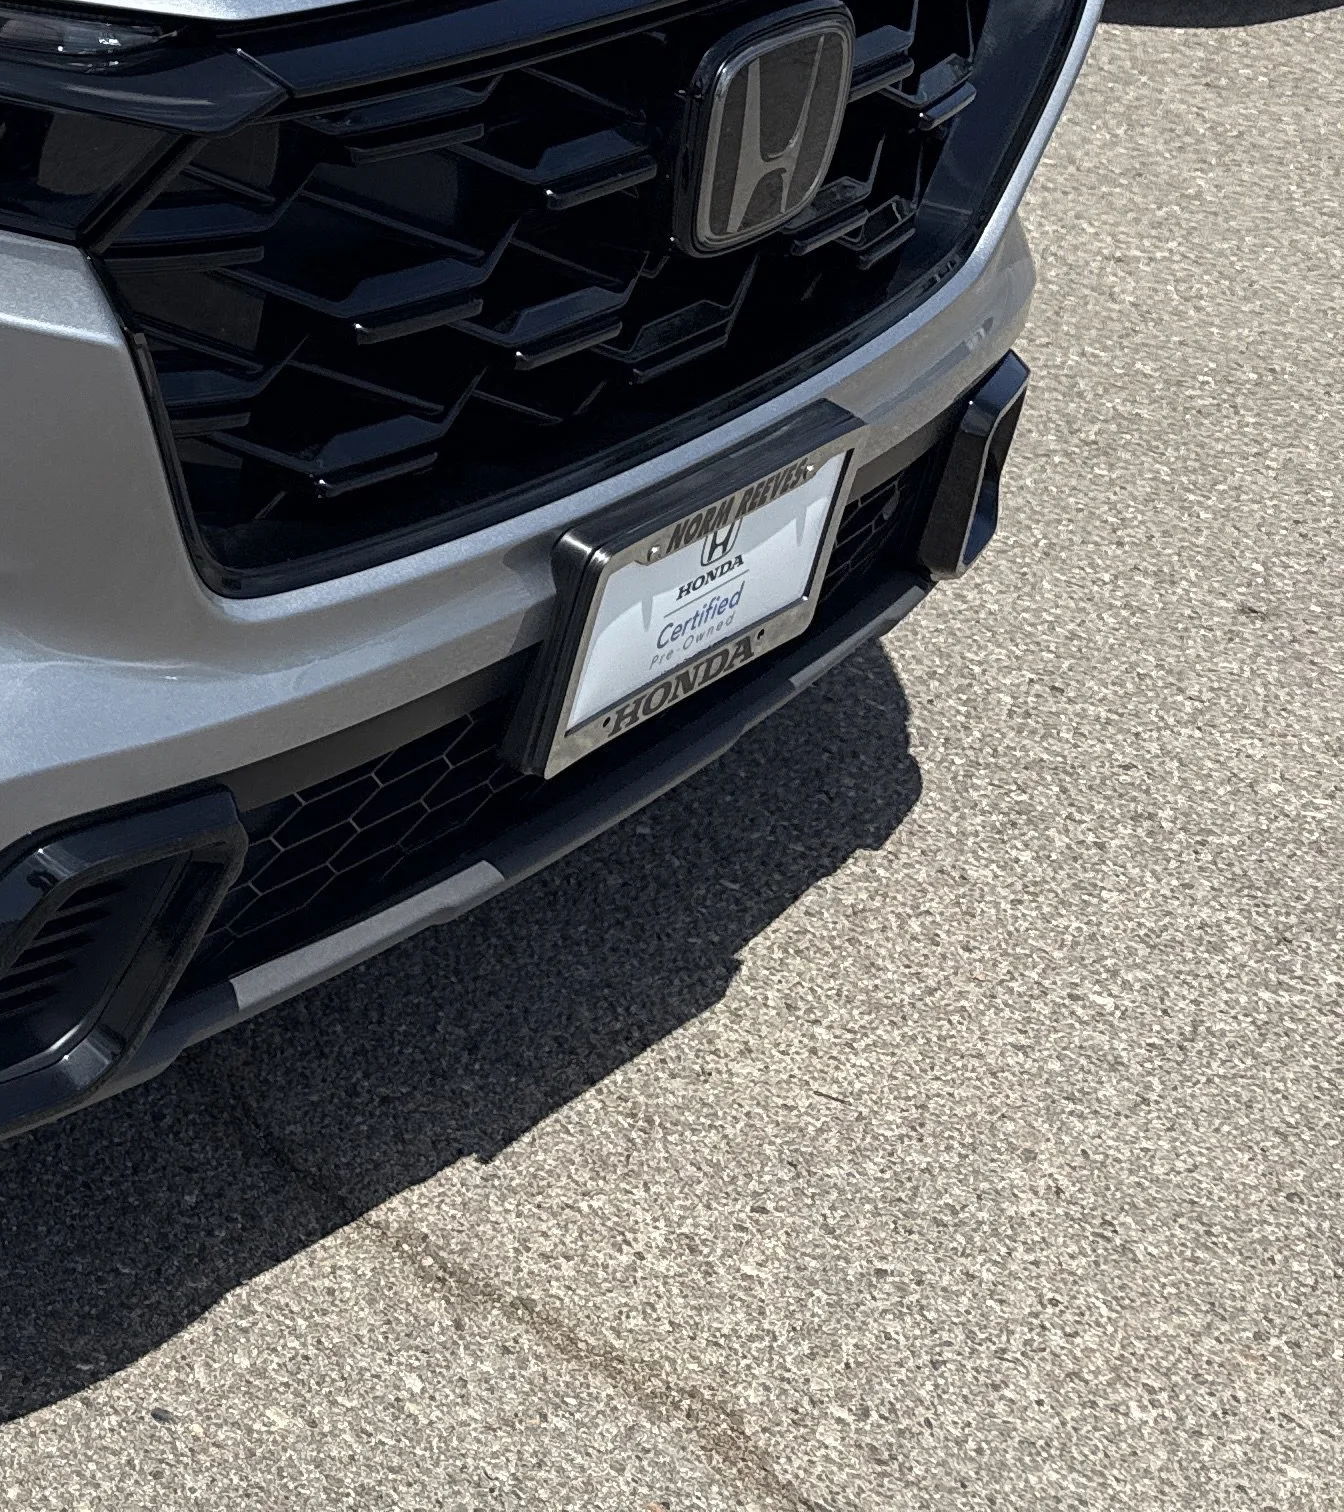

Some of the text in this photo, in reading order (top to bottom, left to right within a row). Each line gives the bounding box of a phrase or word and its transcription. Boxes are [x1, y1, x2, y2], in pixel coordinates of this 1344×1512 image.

[666, 458, 806, 554] NORM REEVES
[676, 554, 745, 601] HONDA
[650, 612, 736, 670] Pre-Owned
[656, 580, 746, 650] Certified
[608, 636, 755, 737] HONDA
